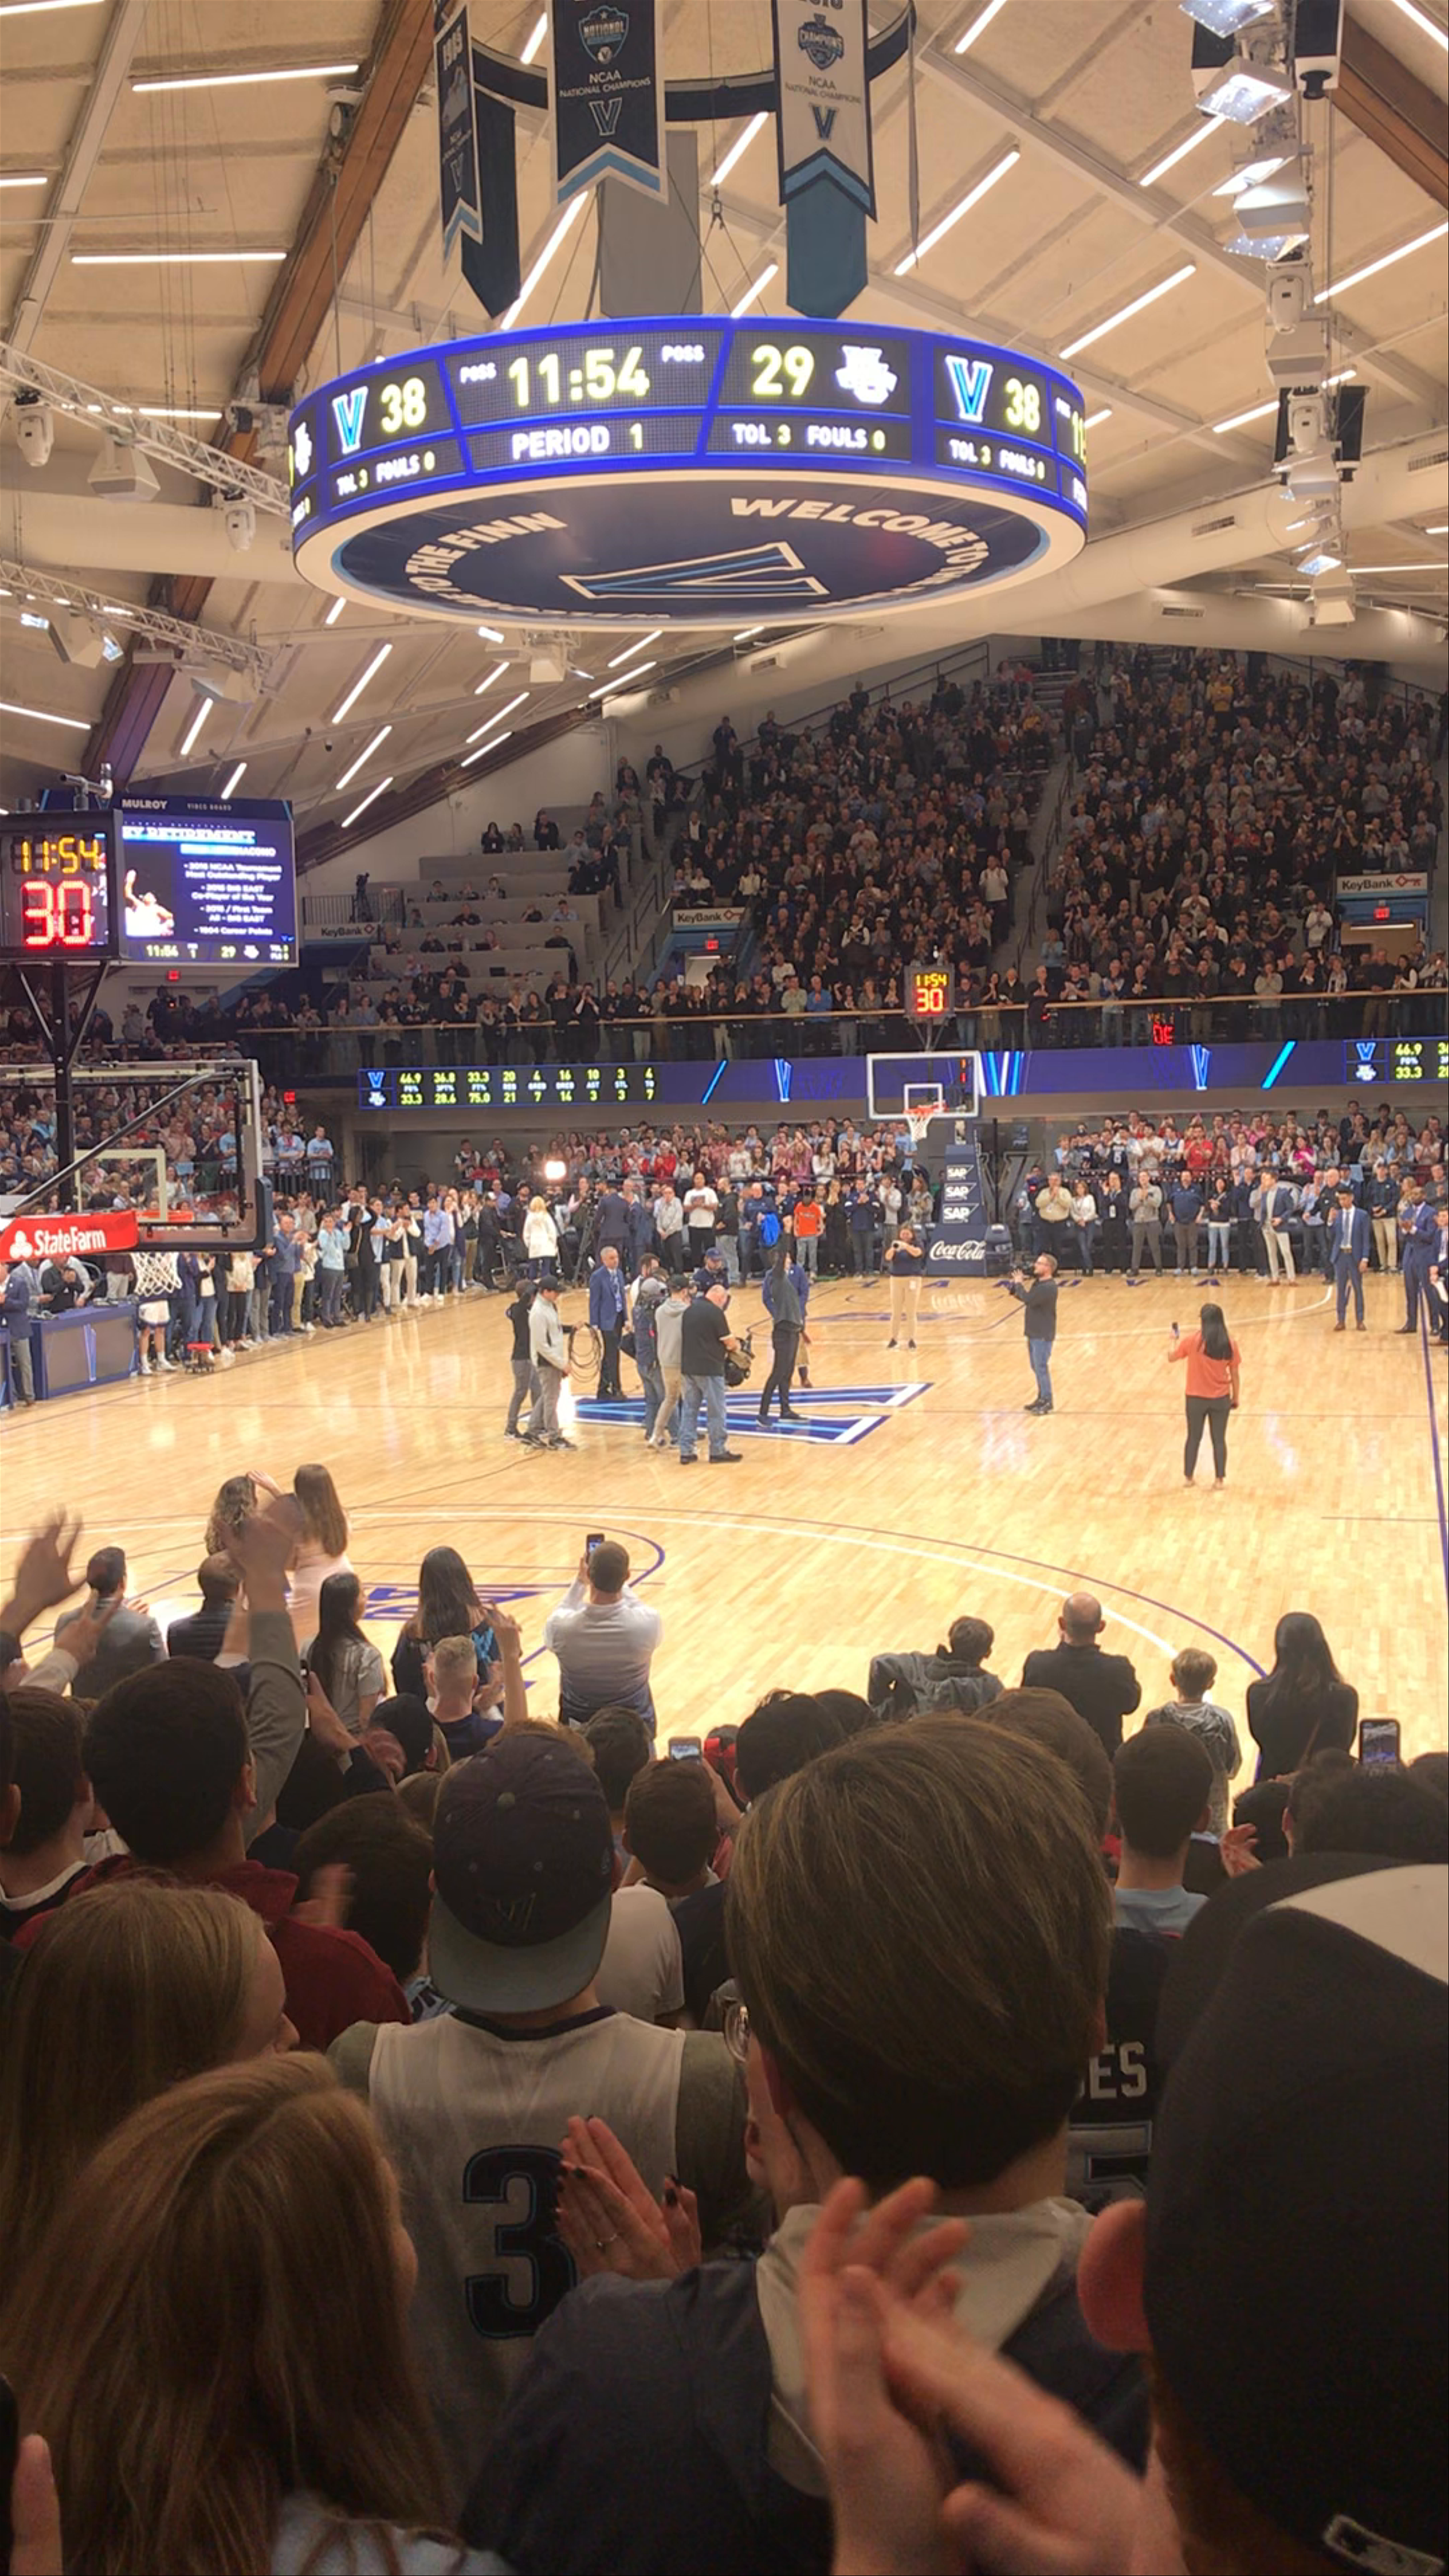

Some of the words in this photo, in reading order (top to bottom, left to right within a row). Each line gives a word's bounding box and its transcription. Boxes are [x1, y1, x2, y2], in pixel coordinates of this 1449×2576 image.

[589, 70, 621, 83] NCAA
[809, 76, 836, 90] NCAA
[560, 85, 601, 97] NATIONAL
[603, 77, 651, 92] CHAMPIONS
[661, 345, 705, 362] POSS
[460, 363, 497, 383] POSS
[509, 346, 650, 407] 11:54
[752, 344, 814, 396] 29
[380, 377, 426, 432] 38
[1005, 378, 1041, 431] 38
[512, 426, 609, 460] PERIOD
[629, 423, 642, 450] 1
[732, 423, 772, 444] TOL
[778, 424, 791, 444] 3
[807, 425, 867, 448] FOULS
[949, 439, 978, 463] TOL
[981, 445, 992, 465] 3
[1000, 449, 1035, 477] FOULS
[358, 469, 368, 488] 3
[376, 455, 420, 483] FOULS
[731, 498, 980, 549] WELCOME
[944, 541, 989, 564] TO
[405, 544, 467, 575] THE
[437, 512, 568, 550] FINN
[122, 799, 167, 809] MULROY
[22, 836, 99, 873] 11:54
[207, 871, 255, 881] Outstanding
[257, 873, 281, 881] Player
[210, 863, 235, 871] NCAA
[235, 864, 282, 873] Tournament
[1342, 880, 1394, 891] KeyBank
[191, 892, 230, 901] Co-Player
[22, 880, 92, 945] 30
[678, 913, 721, 923] KeyBank
[321, 927, 362, 937] KeyBank
[221, 946, 236, 958] 29
[917, 988, 943, 1012] 30
[1395, 1043, 1422, 1055] 46.9
[400, 1073, 421, 1083] 46.9
[468, 1072, 489, 1083] 33.3
[503, 1071, 516, 1082] 20
[559, 1069, 571, 1080] 16
[588, 1069, 600, 1080] 10
[617, 1068, 625, 1079] 3
[645, 1067, 653, 1078] 4
[1395, 1066, 1422, 1078] 33.3
[586, 1081, 600, 1089] AST
[401, 1094, 422, 1105] 33.3
[469, 1092, 490, 1103] 75.0
[503, 1091, 515, 1103] 21
[534, 1091, 541, 1102] 7
[590, 1090, 597, 1101] 3
[618, 1089, 625, 1101] 3
[646, 1089, 654, 1100] 7
[948, 1168, 967, 1178] SAP
[946, 1186, 969, 1197] SAP
[944, 1207, 971, 1220] SAP
[1078, 2041, 1147, 2099] ES
